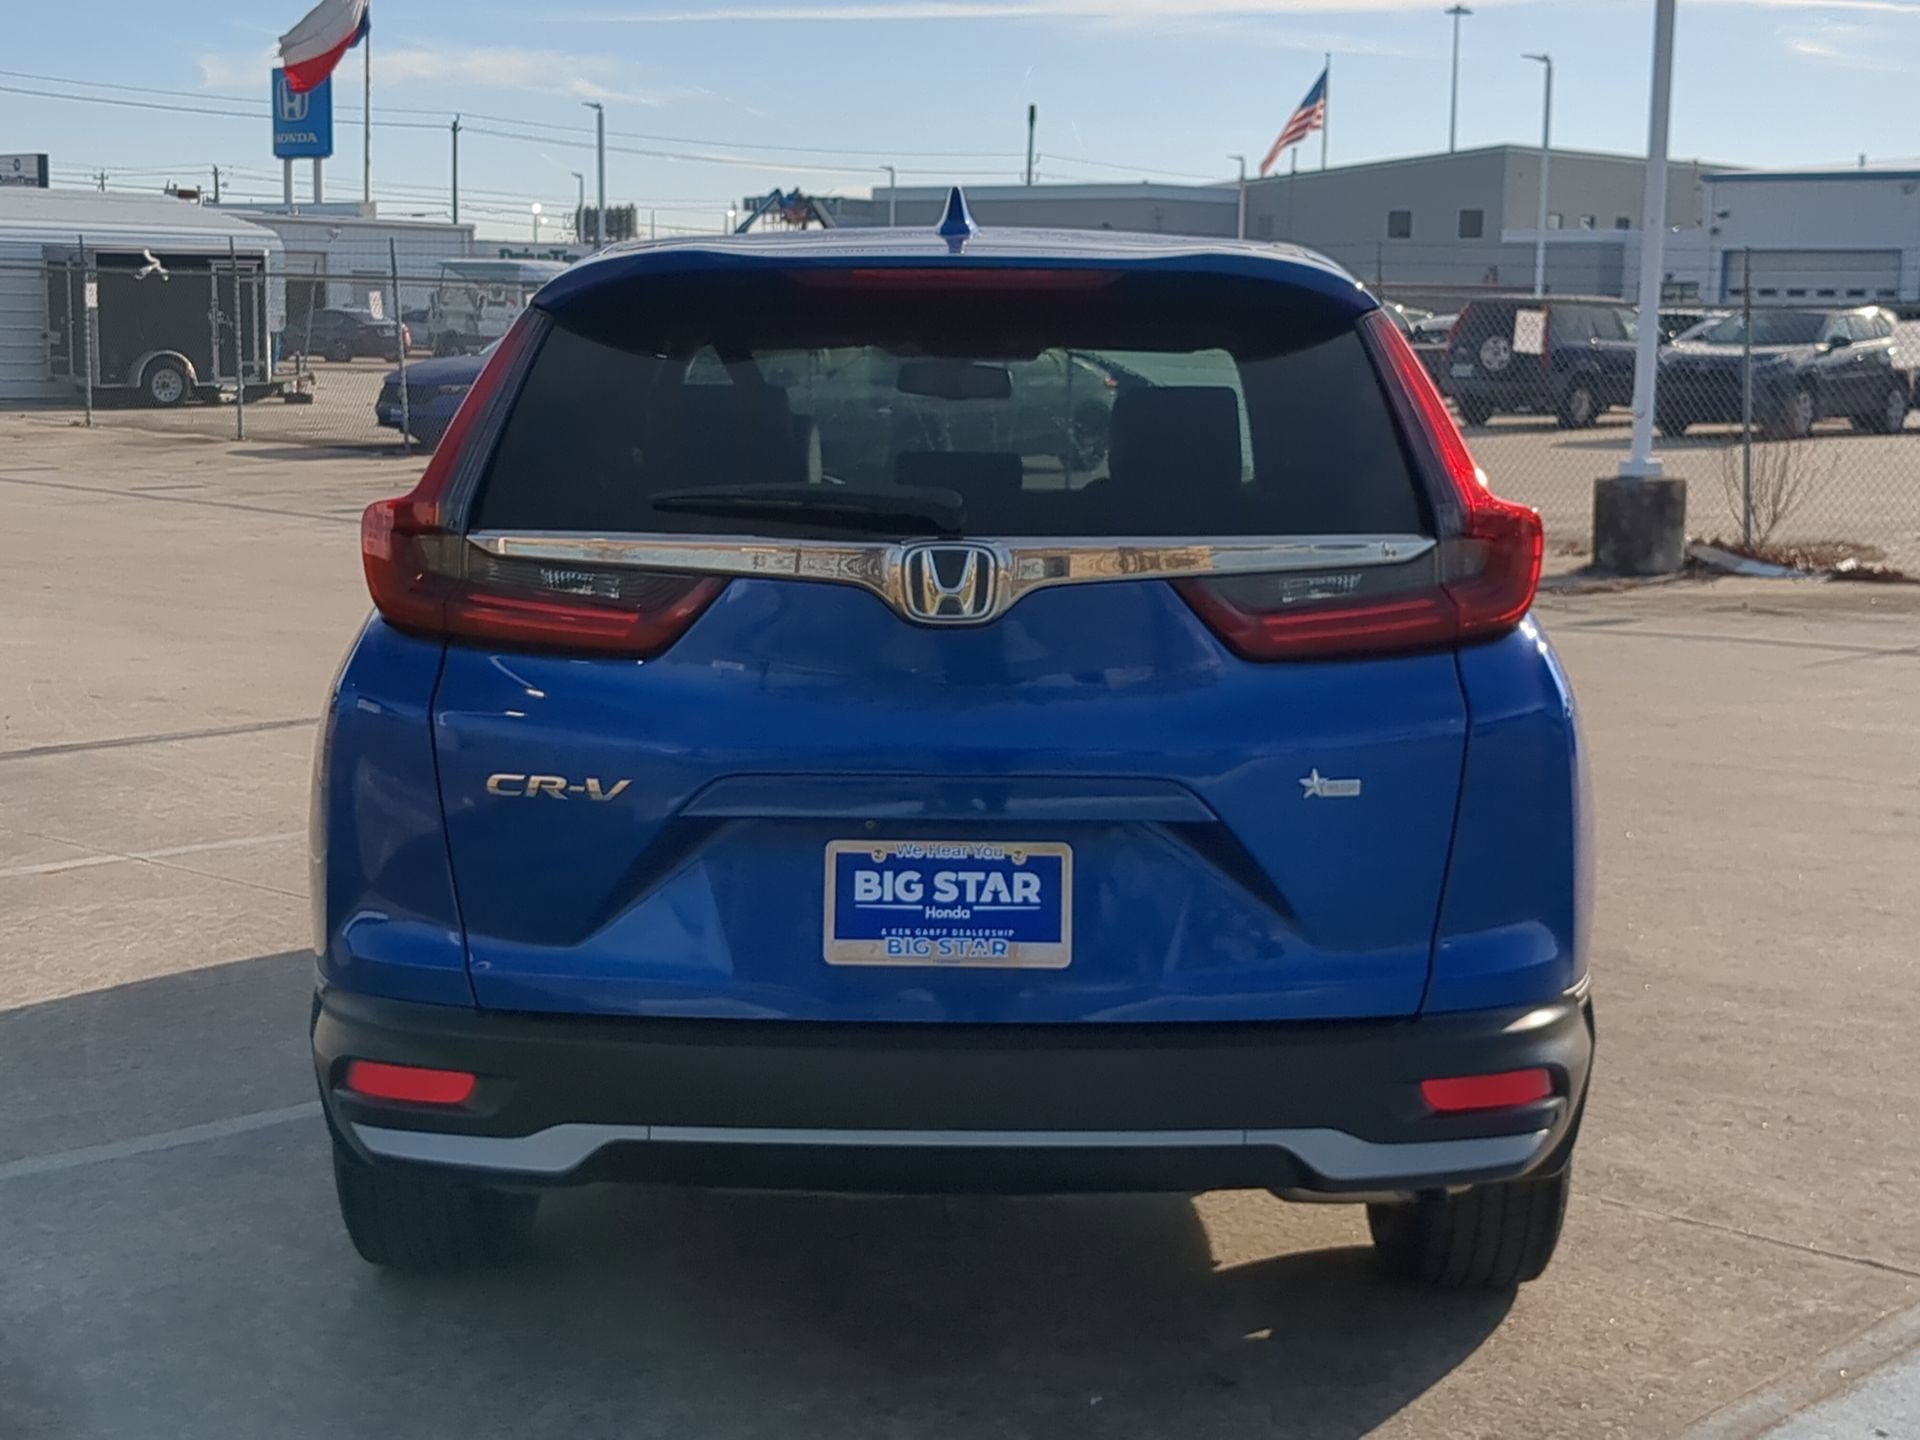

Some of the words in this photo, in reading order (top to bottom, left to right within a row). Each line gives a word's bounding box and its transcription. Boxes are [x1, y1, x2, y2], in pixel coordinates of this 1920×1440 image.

[486, 773, 633, 801] CR-V
[896, 843, 923, 859] We
[927, 844, 968, 859] Hear
[974, 844, 1005, 860] You
[855, 870, 924, 902] BIG
[933, 871, 1041, 903] STAR
[925, 906, 971, 919] Honda
[886, 937, 930, 956] BIG
[938, 938, 1008, 957] STAR
